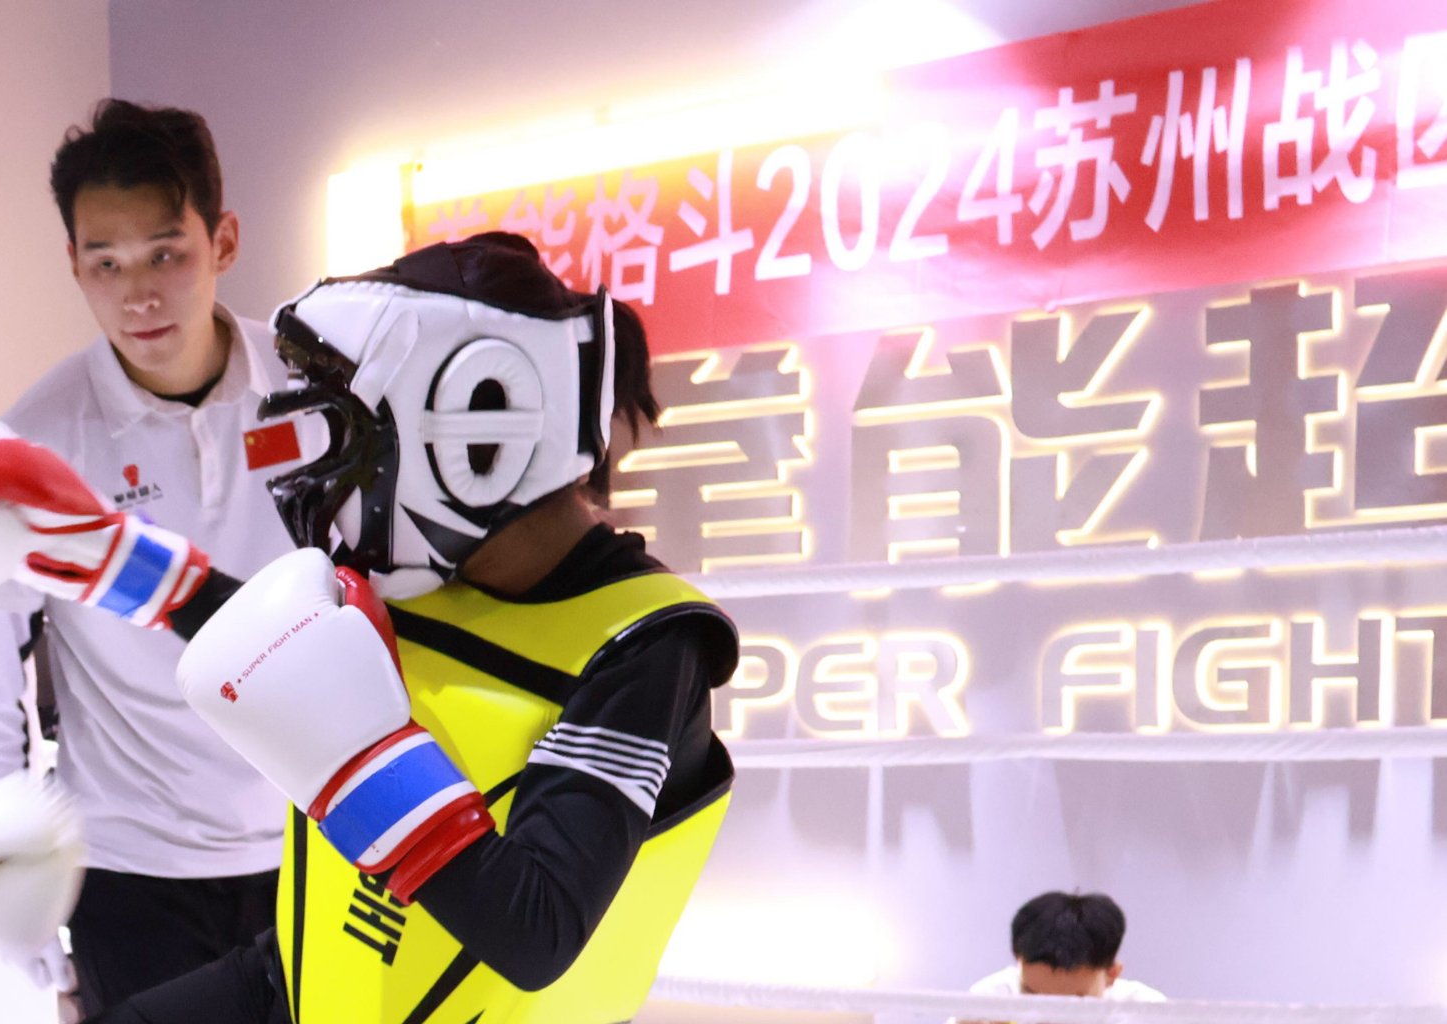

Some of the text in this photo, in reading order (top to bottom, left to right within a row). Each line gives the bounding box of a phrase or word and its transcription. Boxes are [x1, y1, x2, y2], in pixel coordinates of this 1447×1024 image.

[242, 616, 312, 679] SUPER FIGHT MAN
